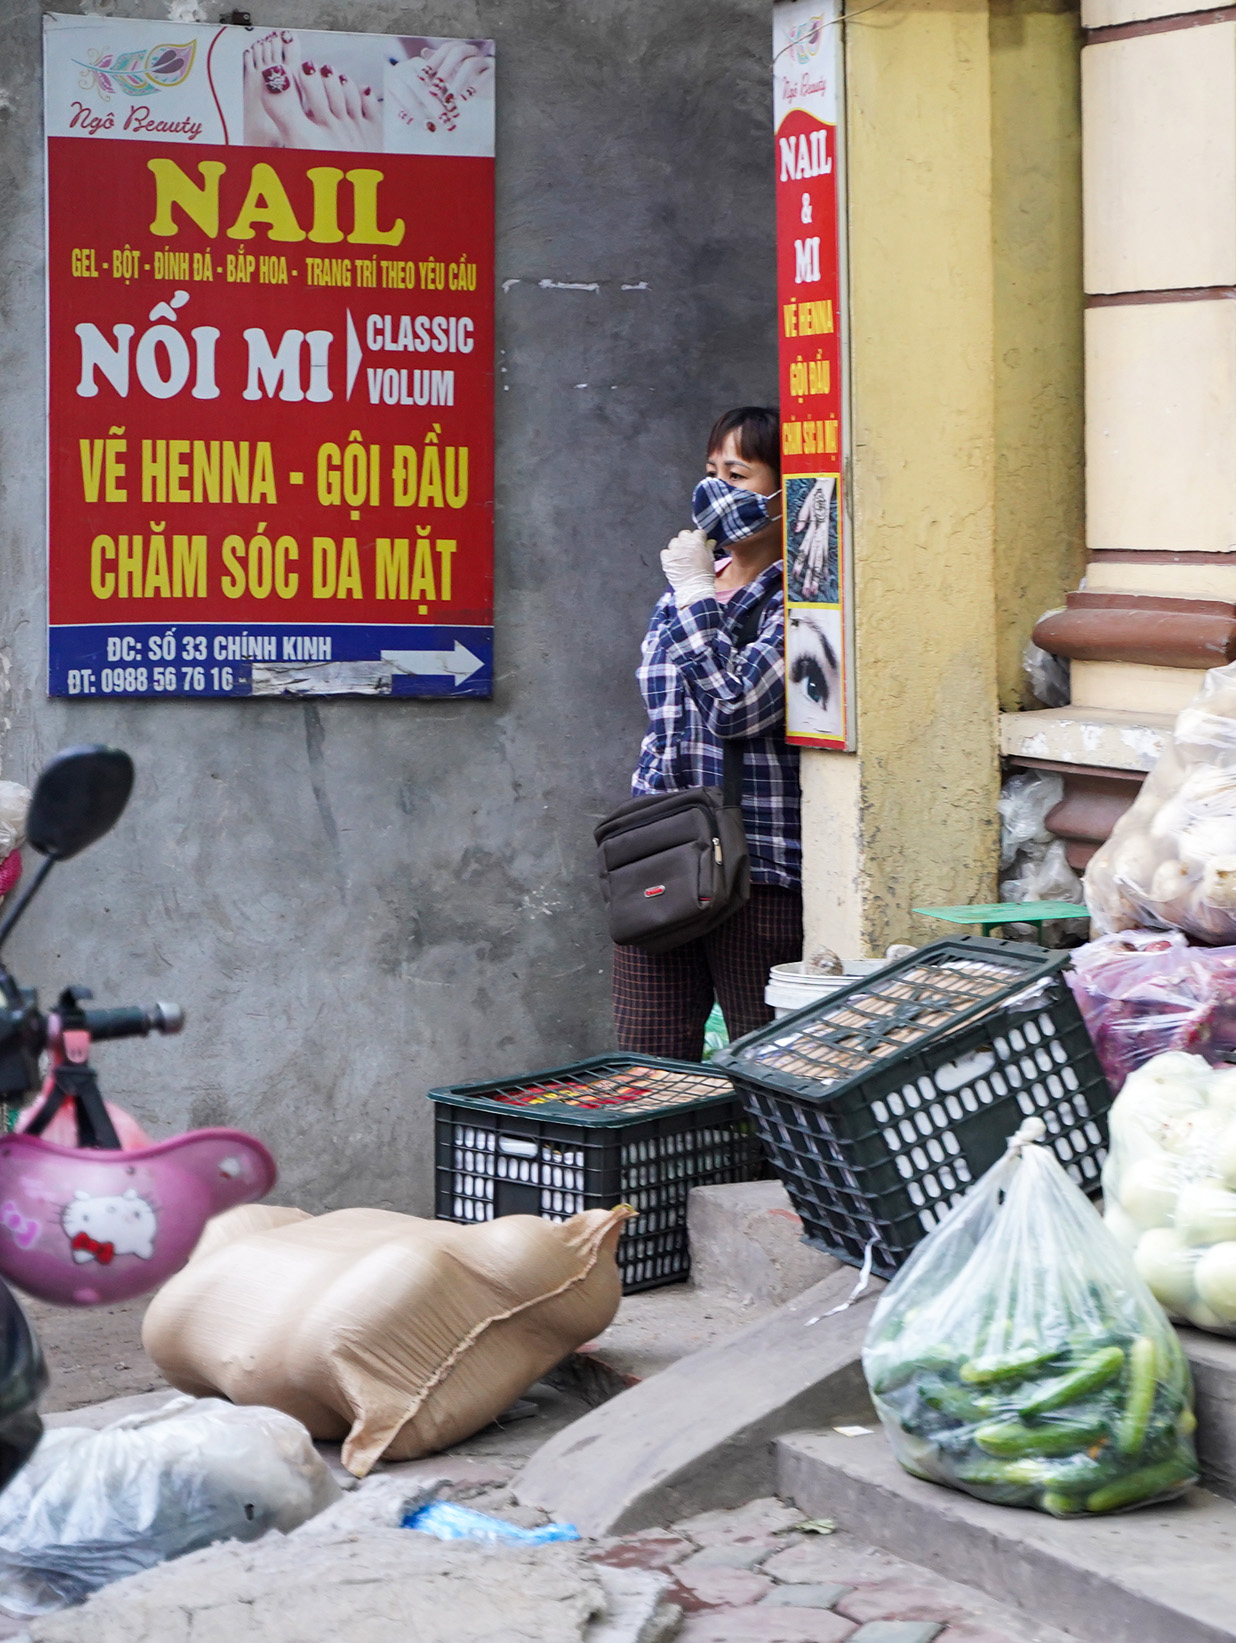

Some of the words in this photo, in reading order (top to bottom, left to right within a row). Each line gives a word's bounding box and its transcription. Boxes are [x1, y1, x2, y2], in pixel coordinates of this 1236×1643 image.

[69, 102, 115, 133] Ngô
[123, 105, 203, 141] Beauty
[779, 129, 832, 182] NAIL
[147, 158, 405, 246] NAIL
[801, 193, 813, 224] &
[71, 248, 98, 277] GEL
[112, 244, 141, 285] BỘT
[154, 246, 189, 281] ĐÍNH
[193, 247, 213, 281] ĐÁ
[227, 244, 255, 283] BẮP
[259, 254, 288, 285] HOA
[305, 257, 351, 287] TRANG
[355, 254, 377, 288] TRÍ
[380, 260, 415, 289] THEO
[418, 256, 445, 290] YÊU
[794, 236, 821, 284] MI
[75, 290, 220, 399] NỐI
[242, 327, 334, 402] MI
[367, 314, 474, 353] CLASSIC
[367, 368, 454, 406] VOLUM
[80, 426, 127, 503] VẼ
[142, 440, 277, 504] HENNA
[317, 430, 380, 521] GỘI
[391, 423, 469, 509] ĐẦU
[91, 521, 207, 599] CHĂM
[221, 522, 299, 599] SÓC
[312, 537, 363, 599] DA
[375, 526, 457, 615] MẶT
[107, 637, 142, 662] ĐC:
[148, 628, 176, 661] SỐ
[182, 636, 207, 661] 33
[213, 631, 277, 661] CHÍNH
[282, 636, 332, 660] KINH
[68, 669, 96, 694] ĐT:
[102, 668, 148, 693] 0988
[153, 667, 176, 691] 56
[181, 667, 205, 691] 76
[210, 666, 234, 690] 16
